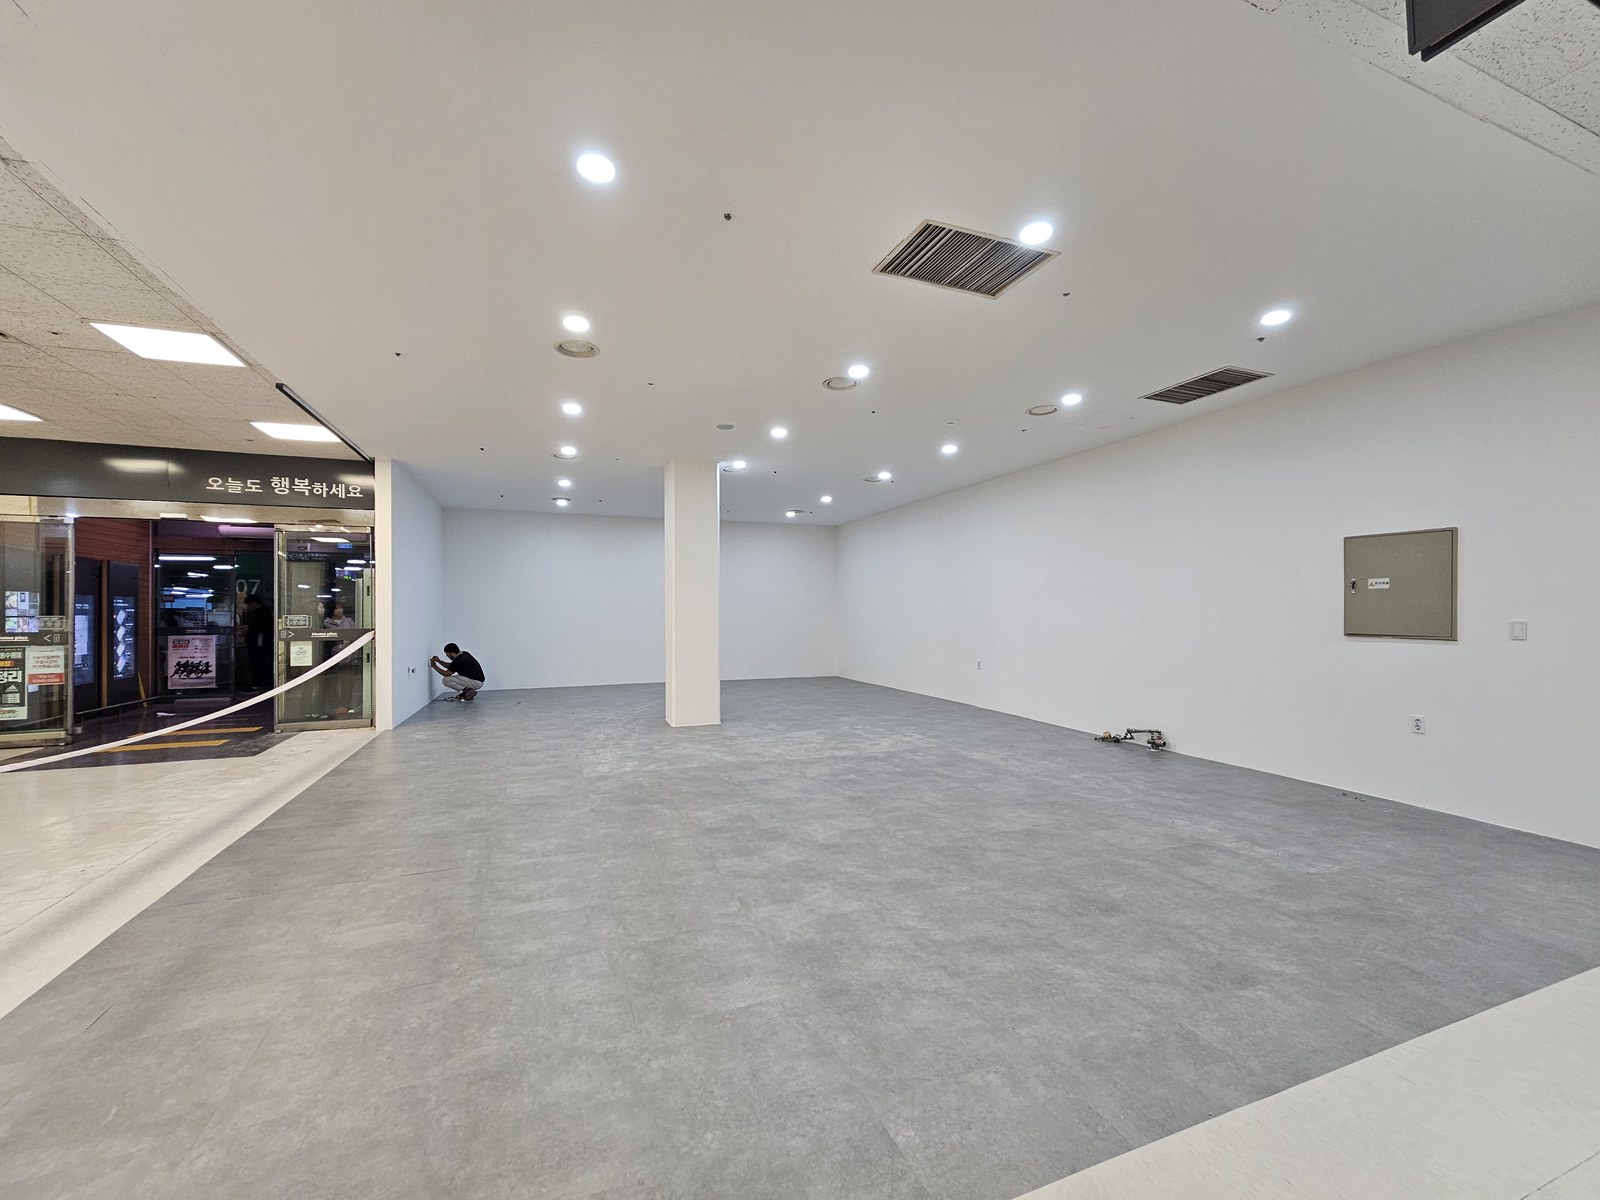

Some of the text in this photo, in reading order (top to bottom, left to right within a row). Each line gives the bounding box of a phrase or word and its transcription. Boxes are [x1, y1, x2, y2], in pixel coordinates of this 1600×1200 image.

[205, 476, 364, 499] 오늘도 행복하세요
[235, 578, 261, 595] 07
